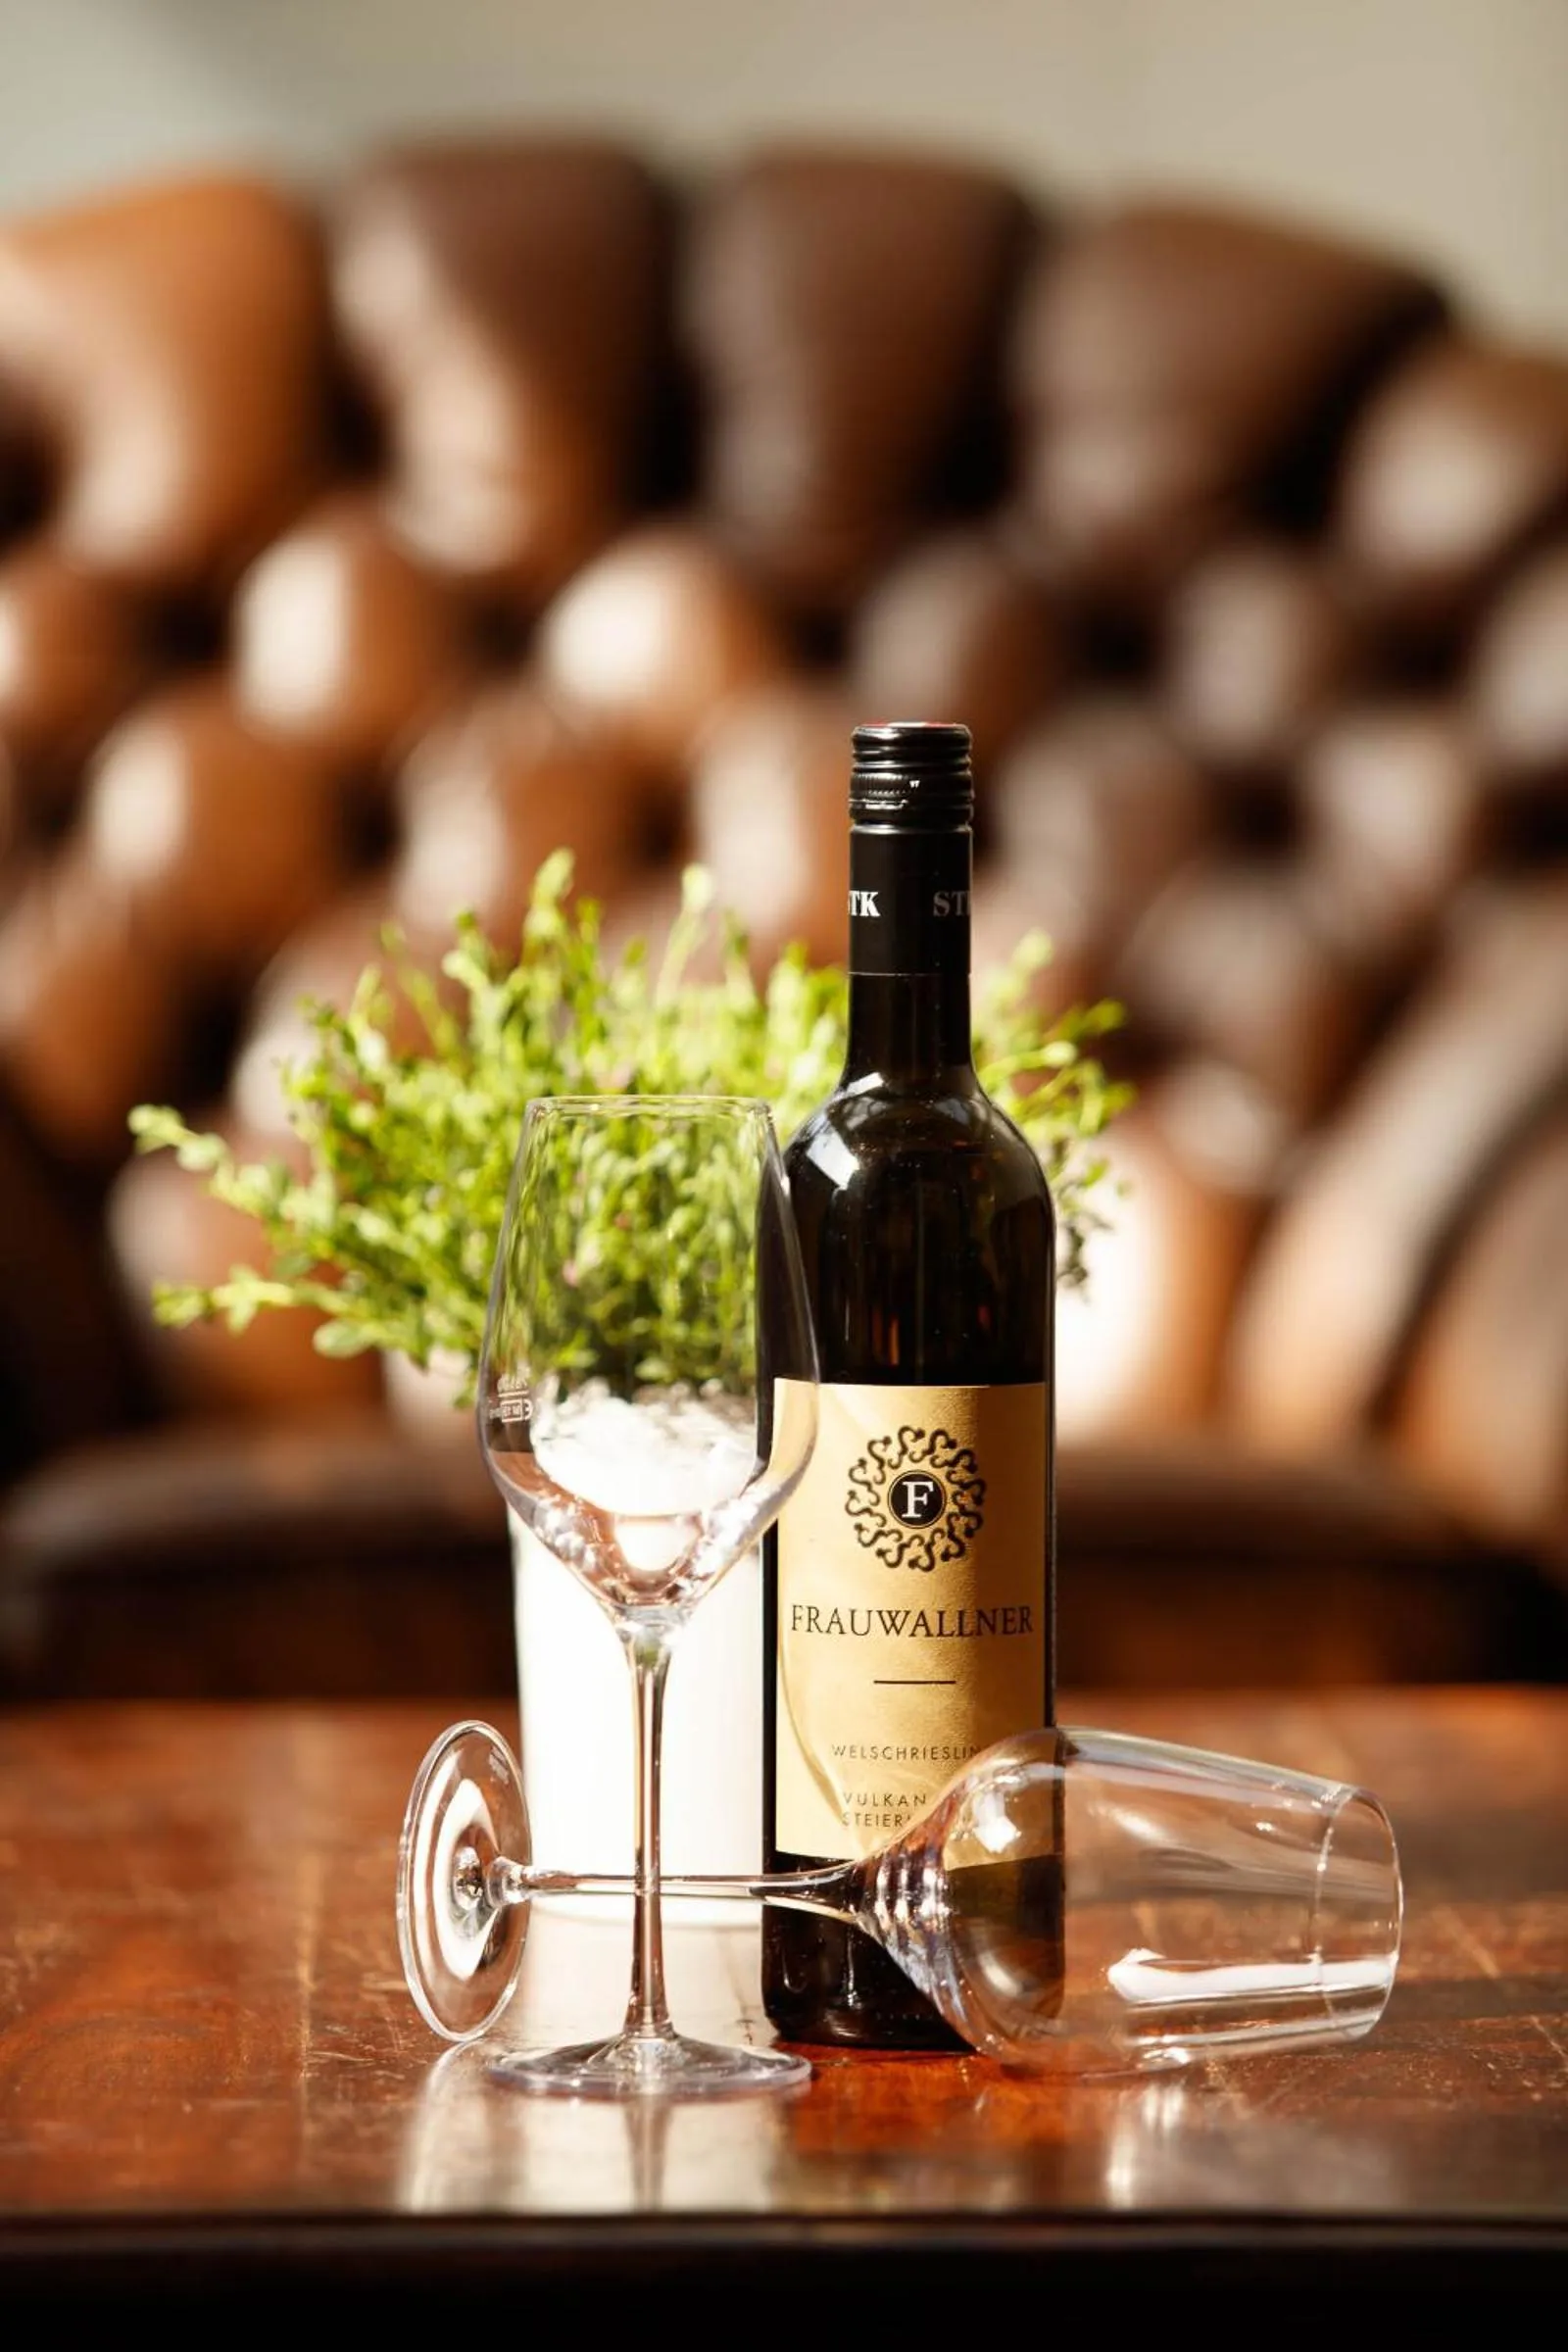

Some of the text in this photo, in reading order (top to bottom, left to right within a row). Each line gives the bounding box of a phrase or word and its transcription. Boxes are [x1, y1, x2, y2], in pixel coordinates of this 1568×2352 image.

[847, 890, 881, 917] TK
[901, 1480, 935, 1519] F
[790, 1603, 1034, 1639] FRAUWALLNER
[841, 1812, 911, 1829] STEIER
